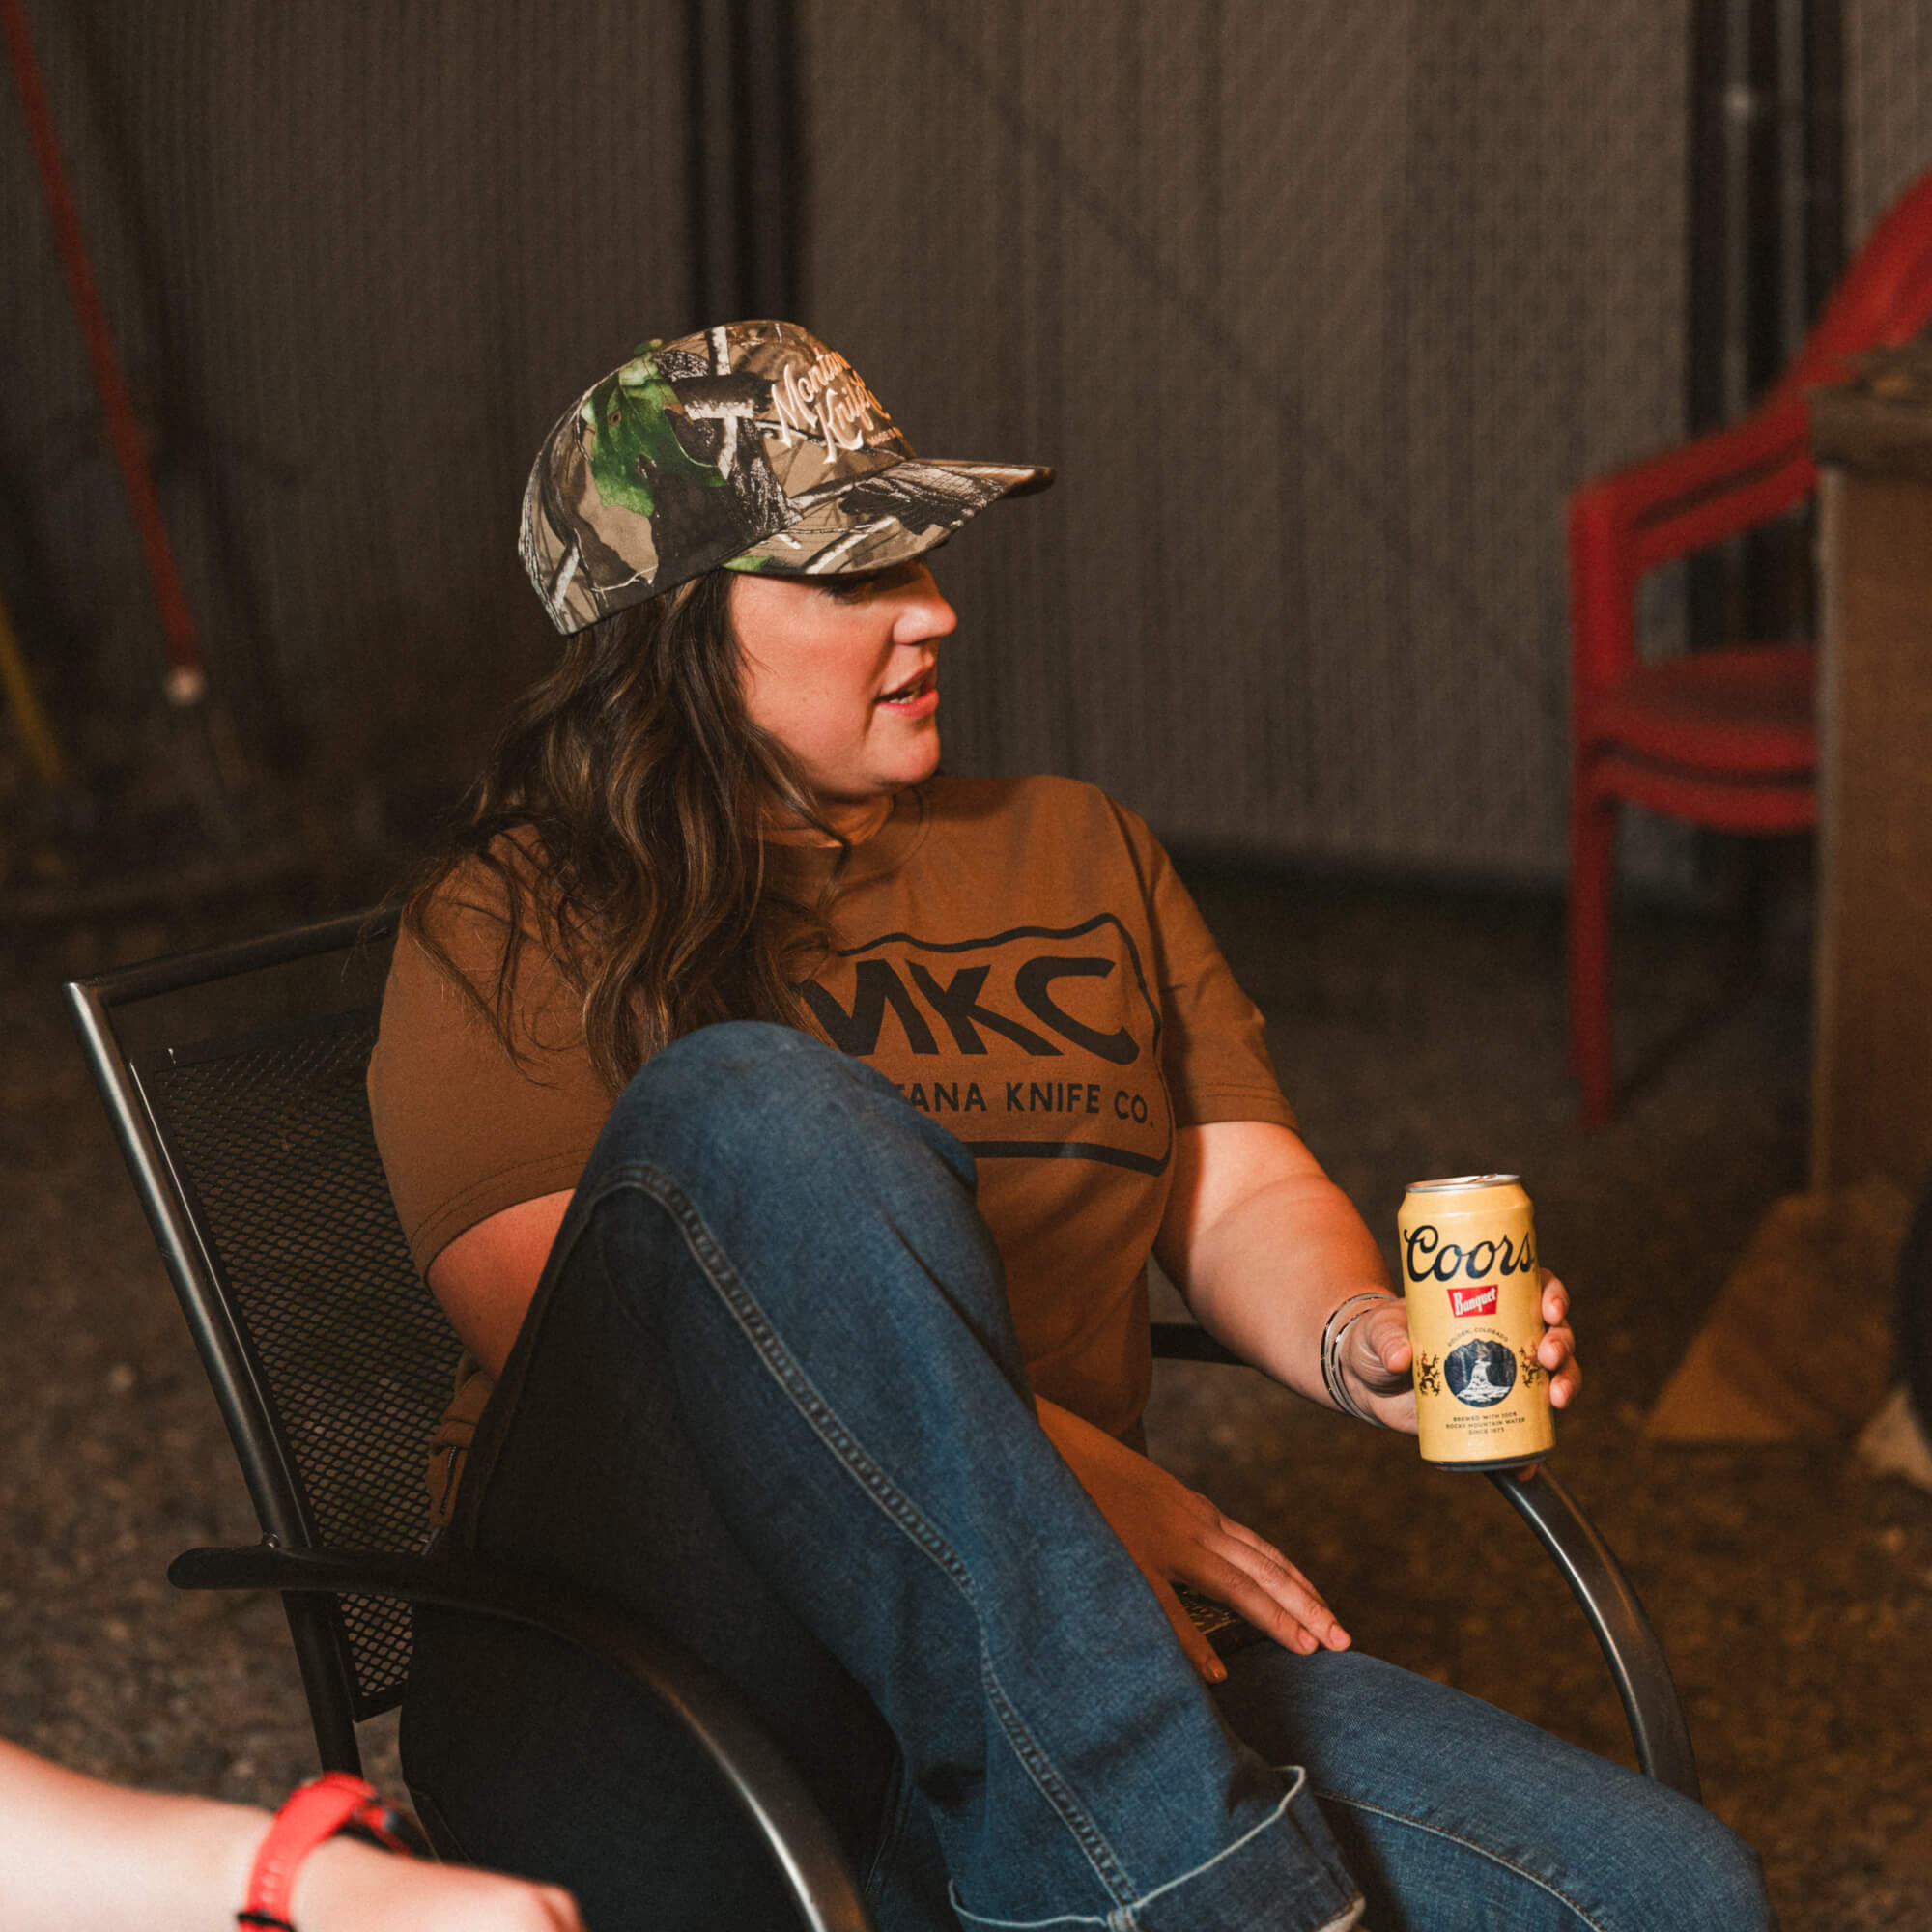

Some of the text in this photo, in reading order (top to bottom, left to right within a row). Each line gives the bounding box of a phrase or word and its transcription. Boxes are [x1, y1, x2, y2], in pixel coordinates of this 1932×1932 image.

[785, 955, 1140, 1065] MKC
[1006, 1082, 1101, 1114] KNIFE
[1114, 1089, 1155, 1128] CO.
[1404, 1224, 1534, 1283] Coors
[1453, 1288, 1495, 1316] Banquet
